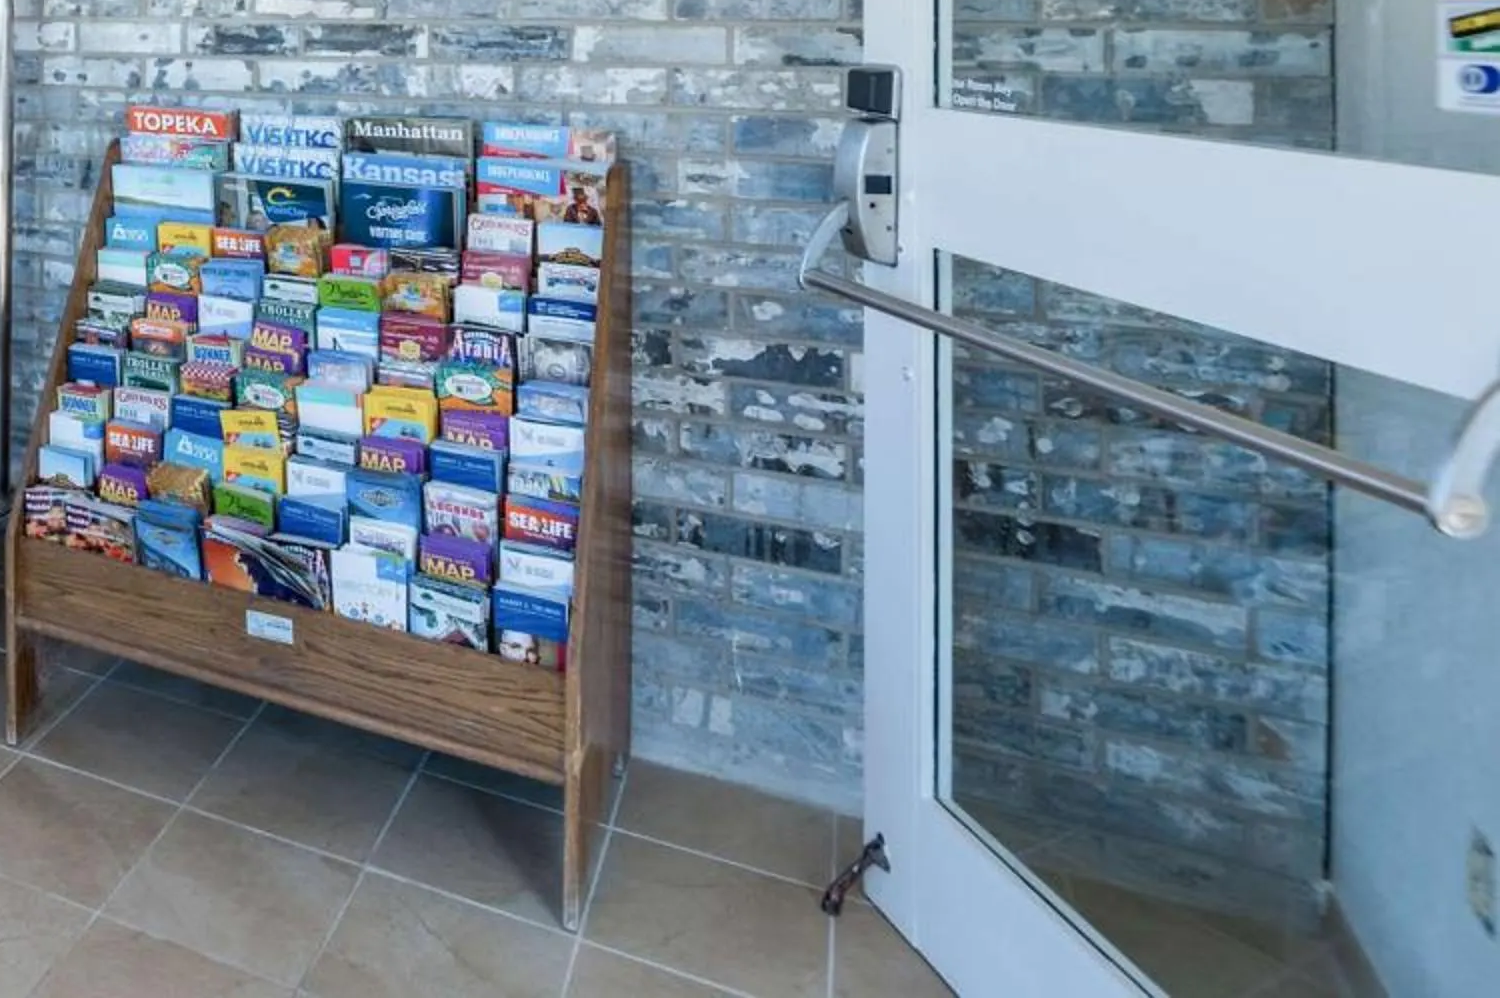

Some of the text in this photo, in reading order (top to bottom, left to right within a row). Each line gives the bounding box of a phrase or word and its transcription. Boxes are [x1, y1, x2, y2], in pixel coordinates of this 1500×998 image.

[133, 111, 218, 135] TOPEKA
[354, 120, 464, 141] Manhattan
[148, 303, 181, 322] MAP
[252, 326, 292, 352] MAP
[360, 451, 405, 473] MAP
[100, 478, 138, 502] MAP
[509, 511, 573, 539] SEA LIFE
[427, 558, 475, 580] MAP
